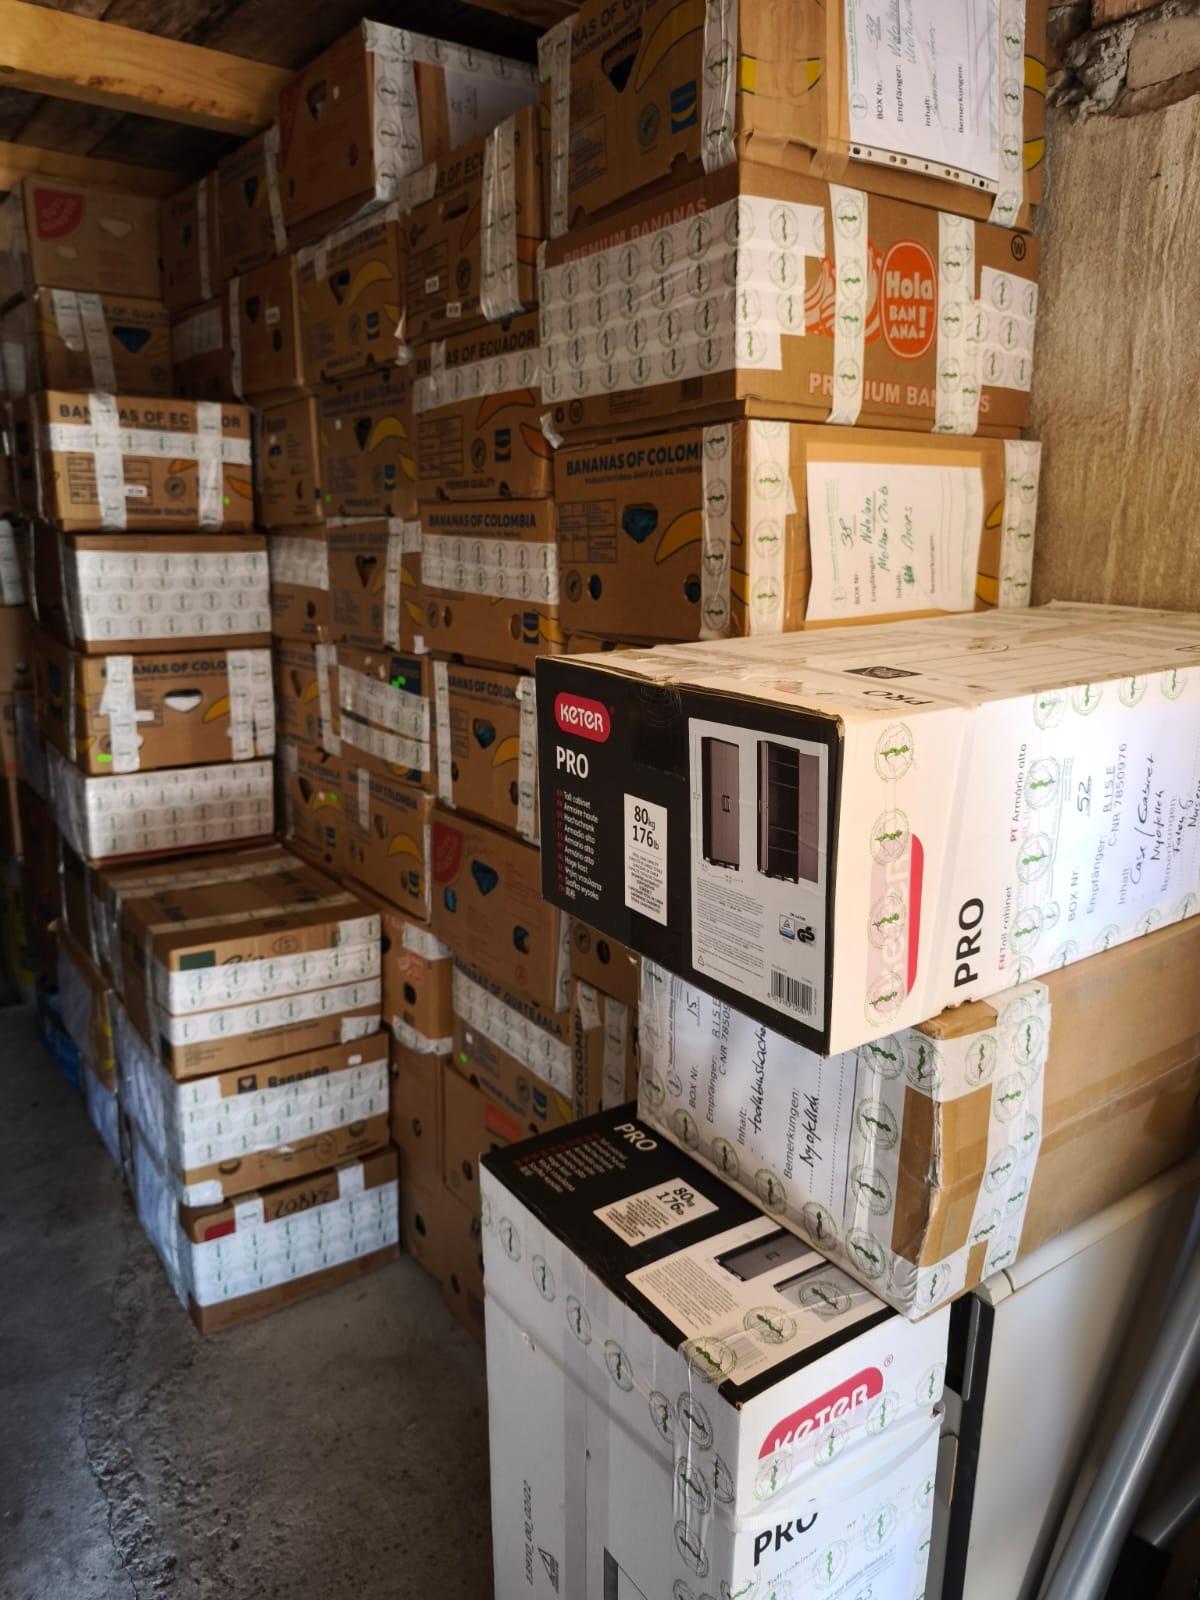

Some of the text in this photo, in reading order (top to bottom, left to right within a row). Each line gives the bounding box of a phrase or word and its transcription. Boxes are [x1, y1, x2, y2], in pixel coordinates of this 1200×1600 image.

[886, 271, 935, 300] Hola
[479, 329, 535, 358] ECUADOR
[809, 372, 900, 404] PRIUM
[145, 410, 165, 424] OF
[566, 453, 625, 476] BANANAS
[627, 450, 645, 468] OF
[647, 442, 702, 465] COLOM
[428, 513, 537, 528] BANANAS OF COLOMBIA
[556, 744, 589, 779] PRO
[1114, 743, 1127, 808] 7850976
[1009, 827, 1018, 842] PT
[953, 897, 984, 988] PRO
[719, 1050, 728, 1076] C-NR
[687, 1064, 699, 1109] BOX Nr.
[705, 1055, 718, 1124] Empfänger:
[613, 1122, 658, 1153] PRO
[737, 1107, 748, 1146] Inhalt:
[783, 1087, 800, 1180] Bemerkungen:
